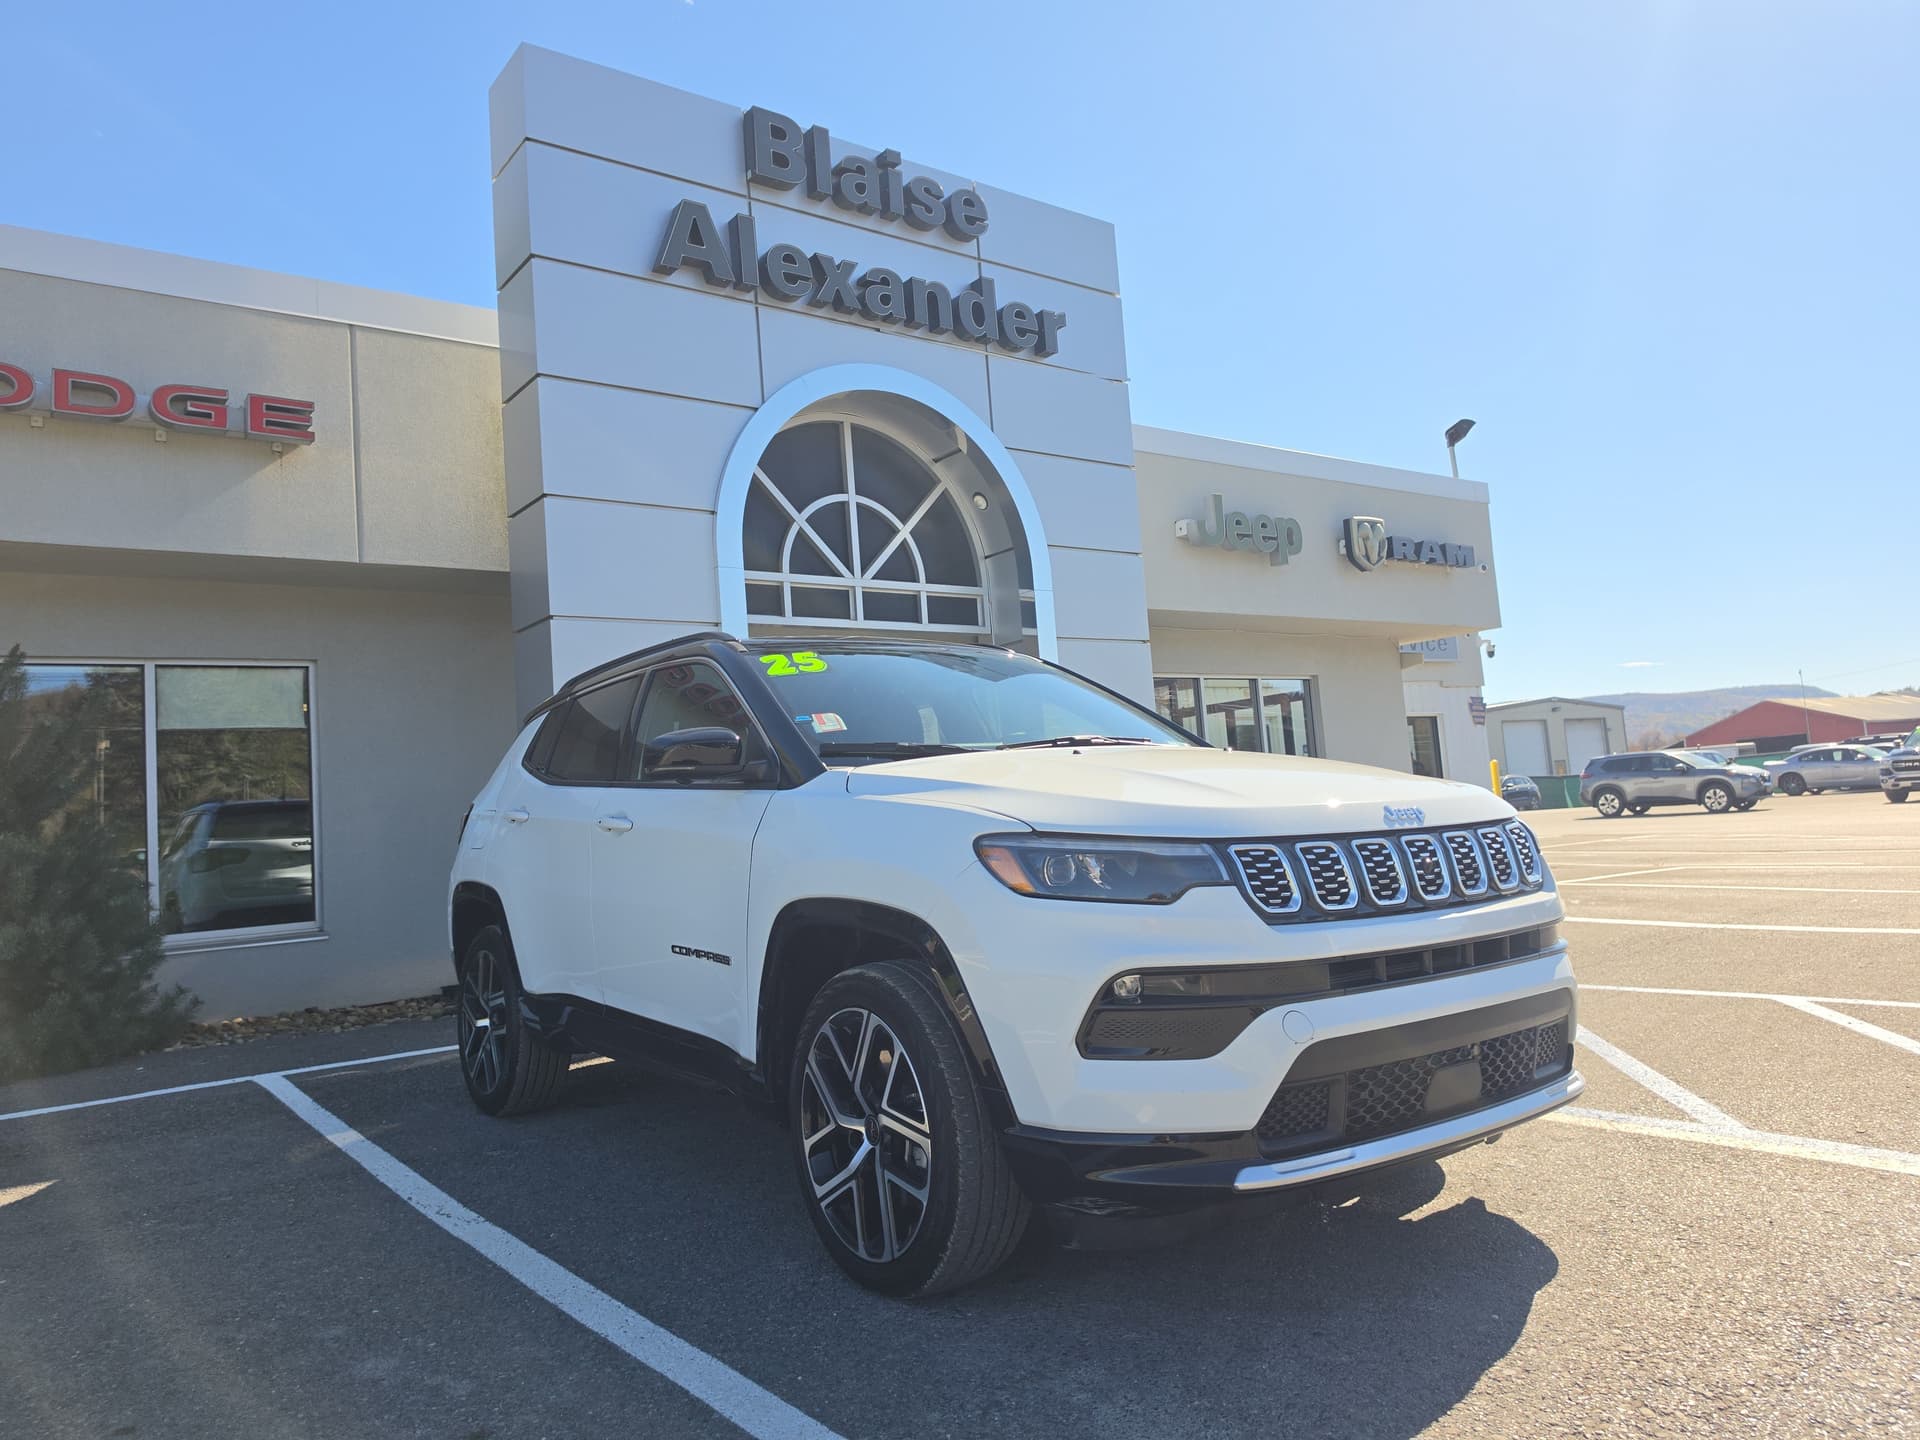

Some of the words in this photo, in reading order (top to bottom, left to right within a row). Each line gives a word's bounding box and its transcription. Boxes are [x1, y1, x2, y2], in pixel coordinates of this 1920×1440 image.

[743, 105, 990, 243] Blaise
[653, 199, 1067, 358] Alexander
[1188, 493, 1303, 567] Jeep
[1387, 535, 1476, 568] RAM
[1400, 638, 1448, 652] vice
[759, 651, 828, 677] 25
[1383, 805, 1425, 828] Jeep
[671, 944, 732, 966] COMPASS
